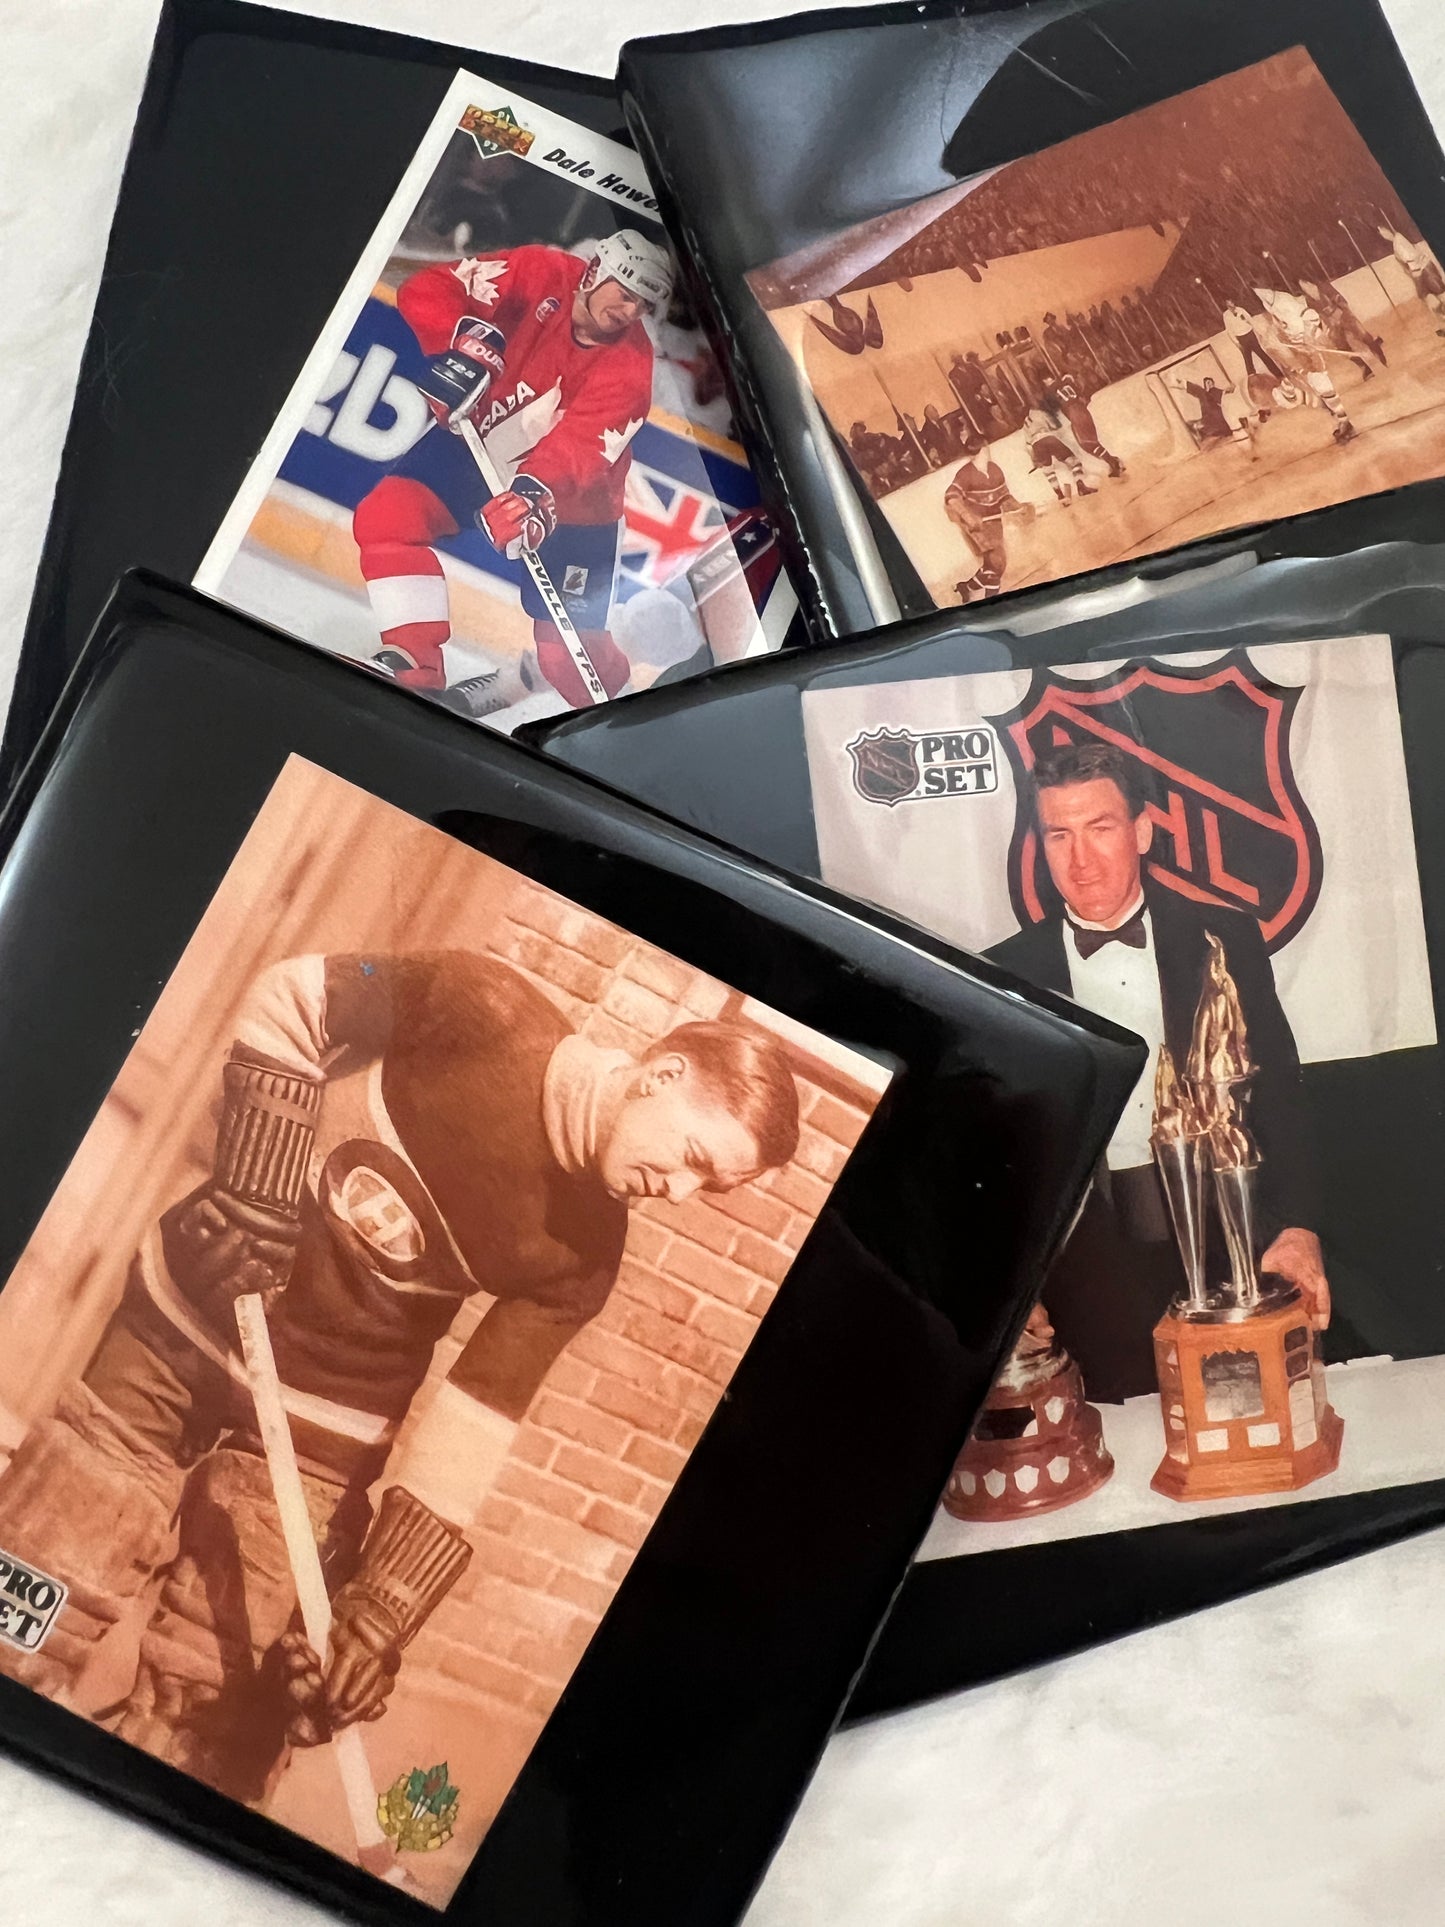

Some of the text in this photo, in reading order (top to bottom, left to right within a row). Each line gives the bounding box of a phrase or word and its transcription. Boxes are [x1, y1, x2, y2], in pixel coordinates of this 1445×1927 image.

[542, 148, 660, 213] Dale Hawe
[575, 647, 603, 694] TPS
[920, 732, 990, 763] PRO
[923, 763, 992, 795] SET
[0, 1598, 42, 1641] ET
